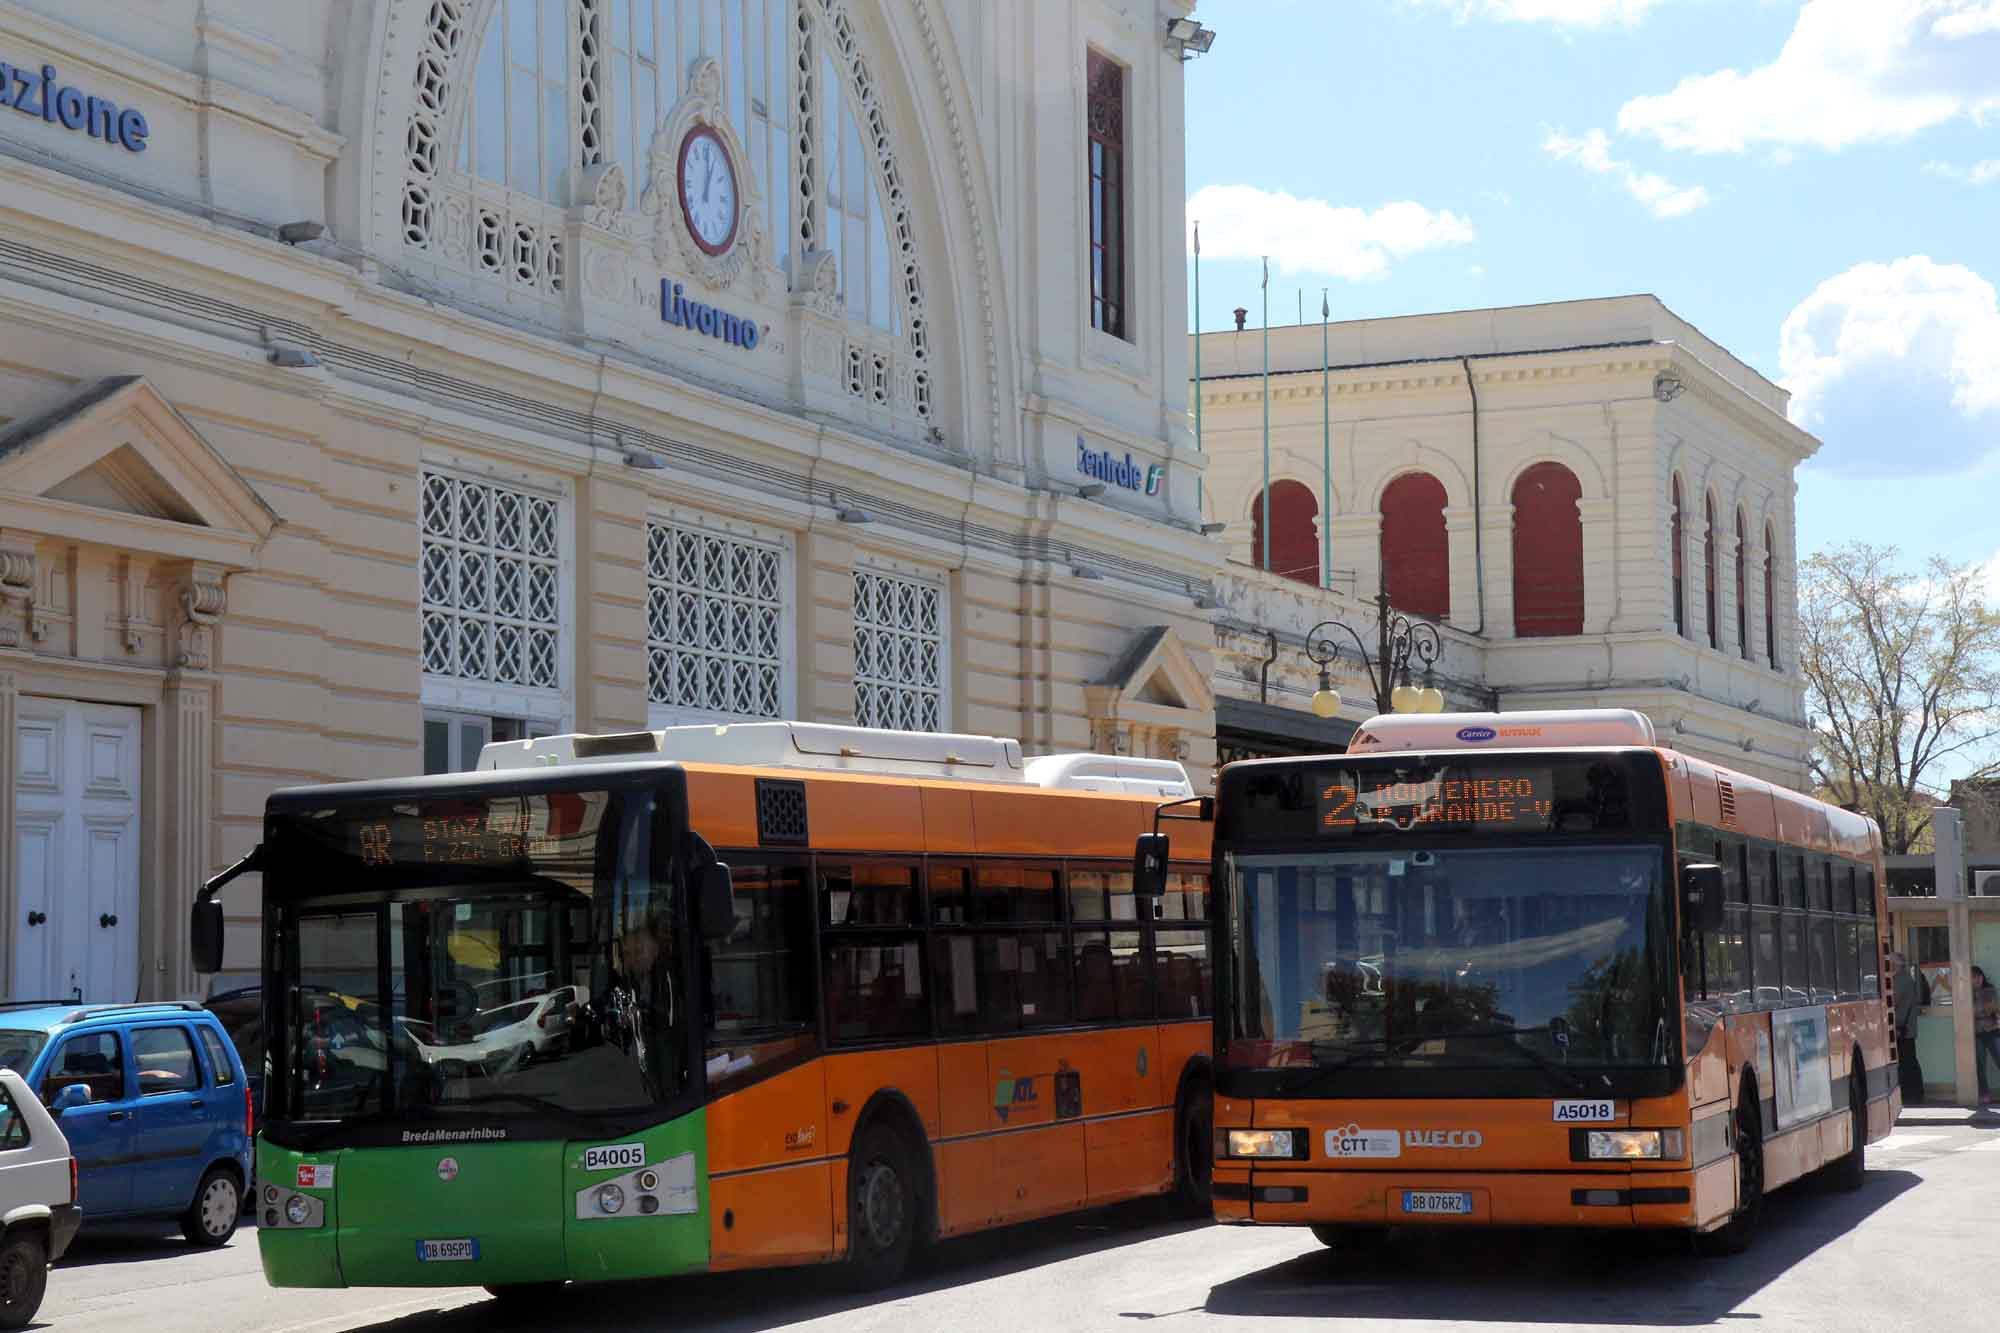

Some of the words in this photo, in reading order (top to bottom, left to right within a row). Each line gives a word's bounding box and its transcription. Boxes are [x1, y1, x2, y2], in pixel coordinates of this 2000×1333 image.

[660, 278, 759, 350] Livorno
[1376, 778, 1533, 801] MONTENERO
[1322, 784, 1357, 825] 2
[1557, 1103, 1610, 1119] A5018
[402, 1128, 506, 1142] BredaMenarinibus
[1341, 1138, 1368, 1151] CTT
[1404, 1129, 1482, 1148] IVECO
[587, 1148, 643, 1167] B4005
[1412, 1195, 1426, 1209] BB
[1428, 1195, 1462, 1210] 076RZ
